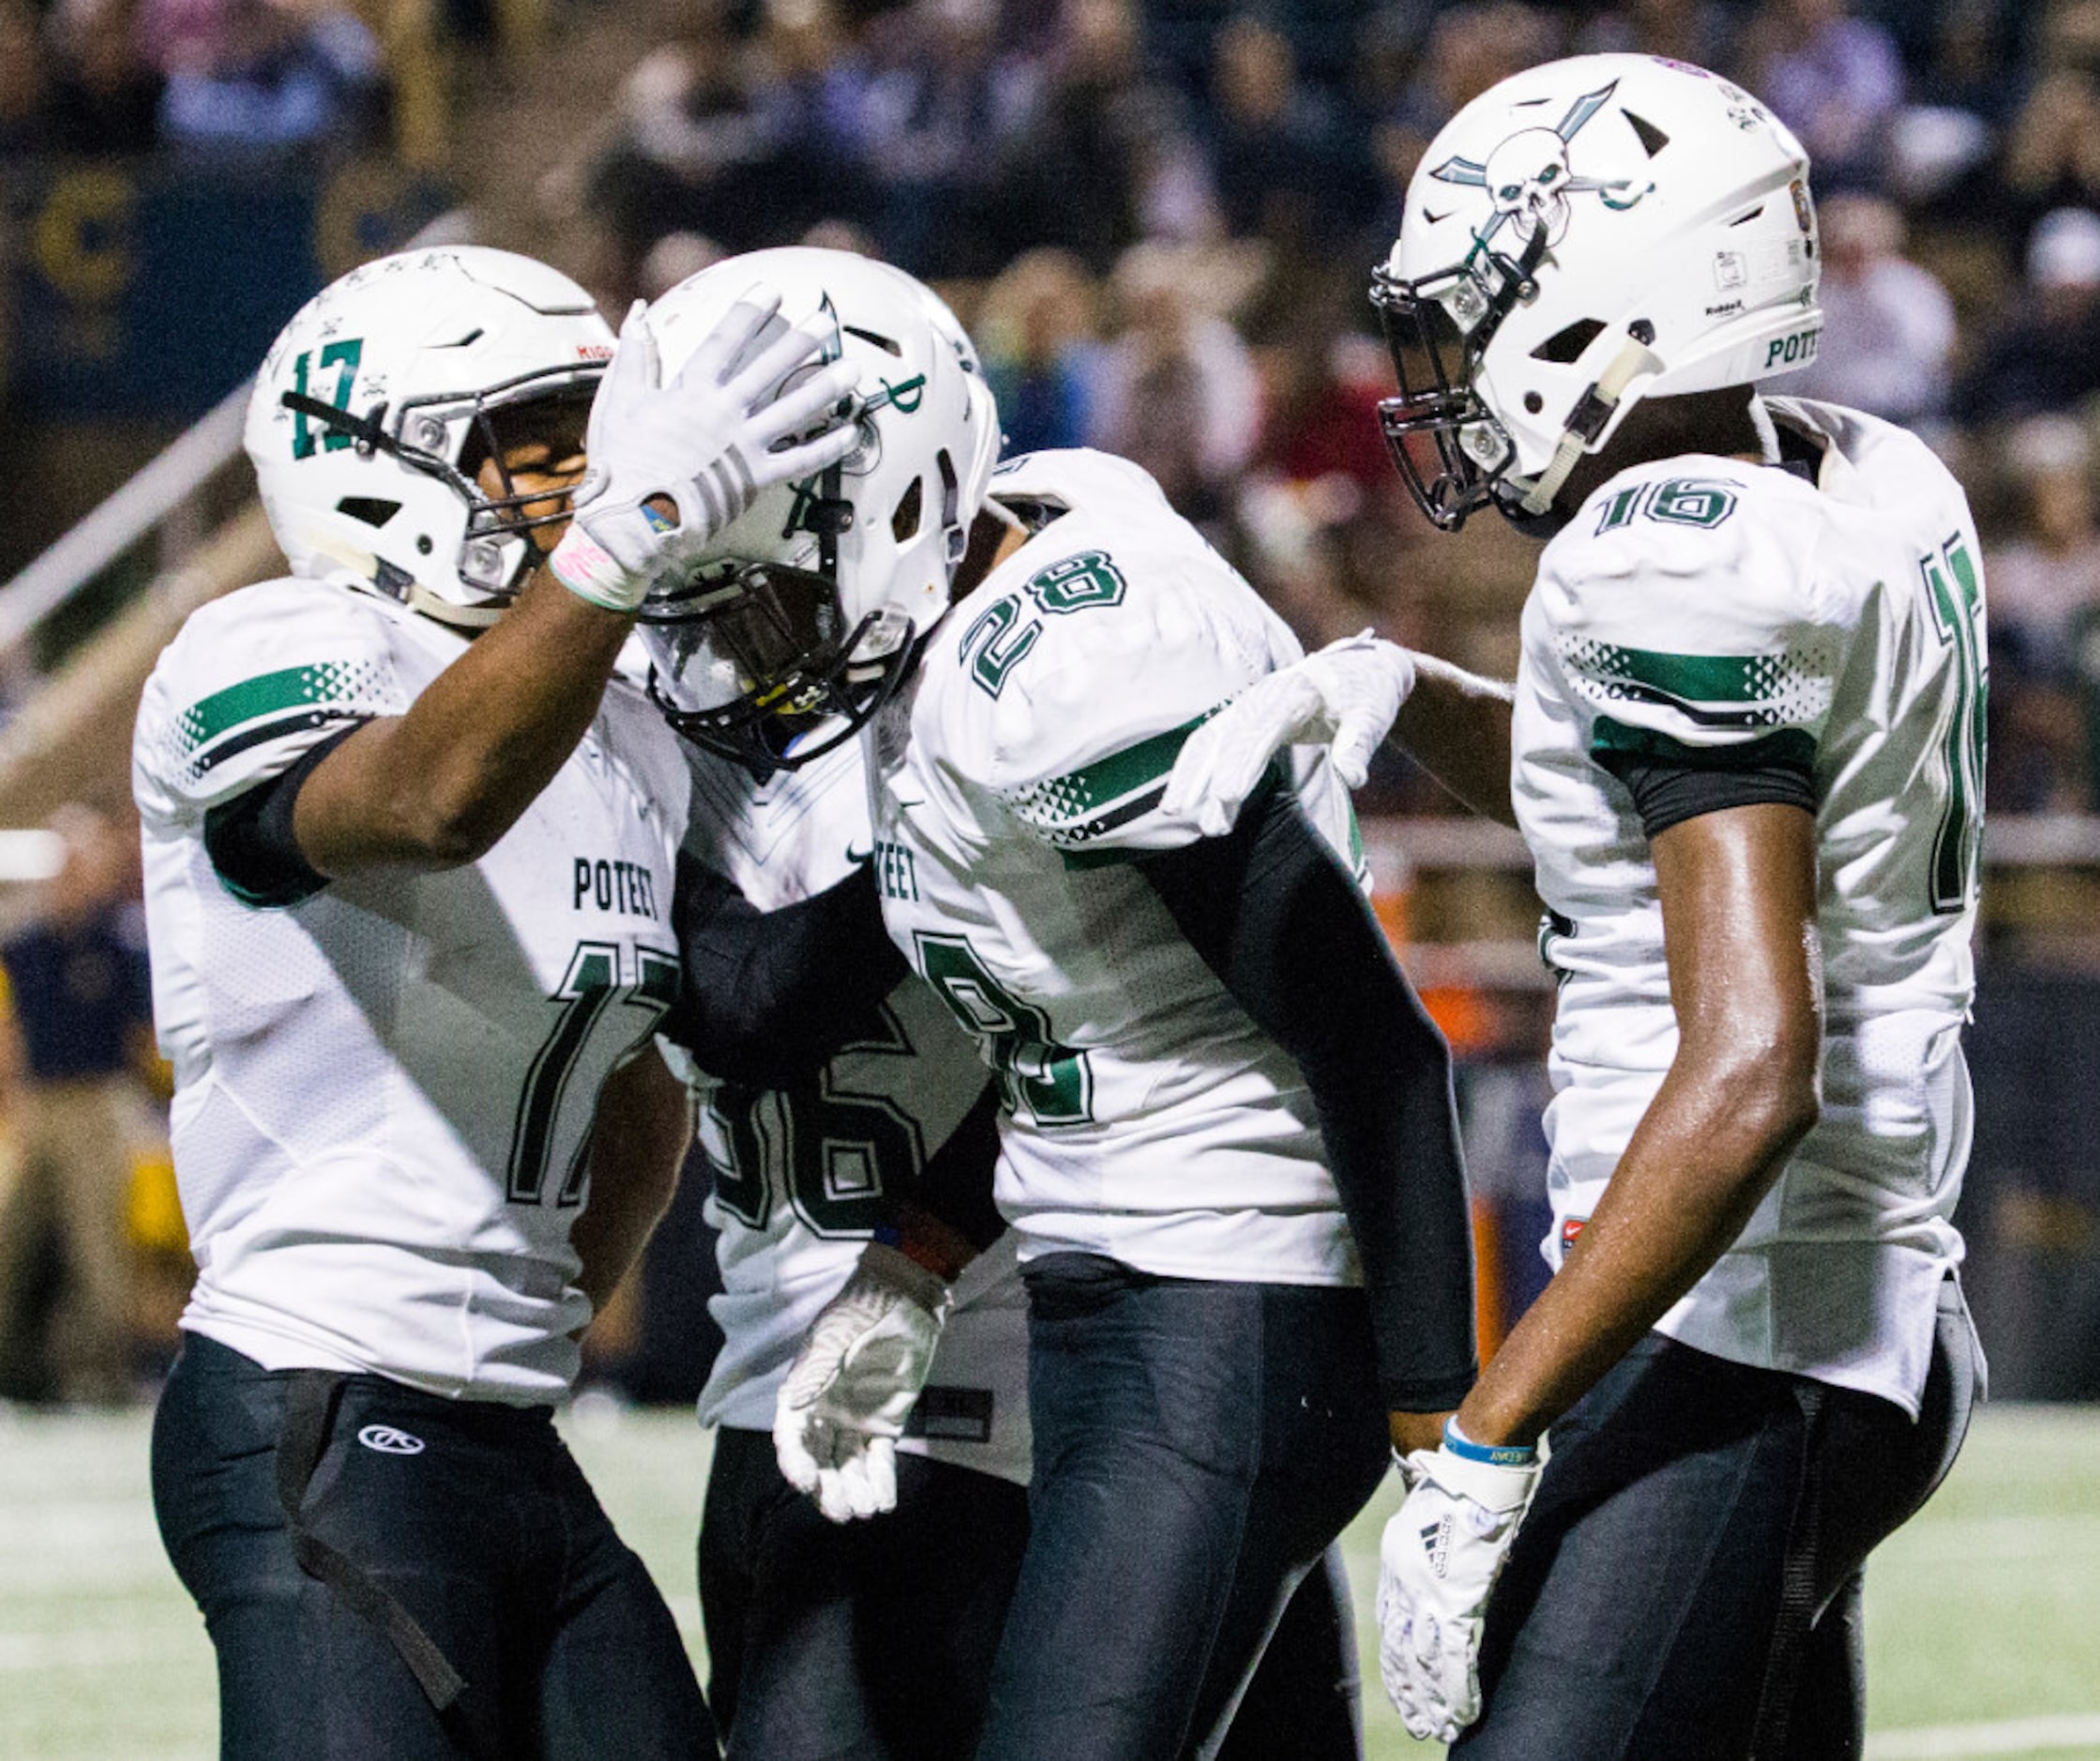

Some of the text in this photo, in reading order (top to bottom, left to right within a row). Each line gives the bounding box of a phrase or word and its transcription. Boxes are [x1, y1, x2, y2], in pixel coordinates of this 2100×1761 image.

[293, 338, 364, 461] 17
[1594, 477, 1748, 538] 16
[959, 549, 1127, 702] 28
[574, 856, 658, 921] POTEET
